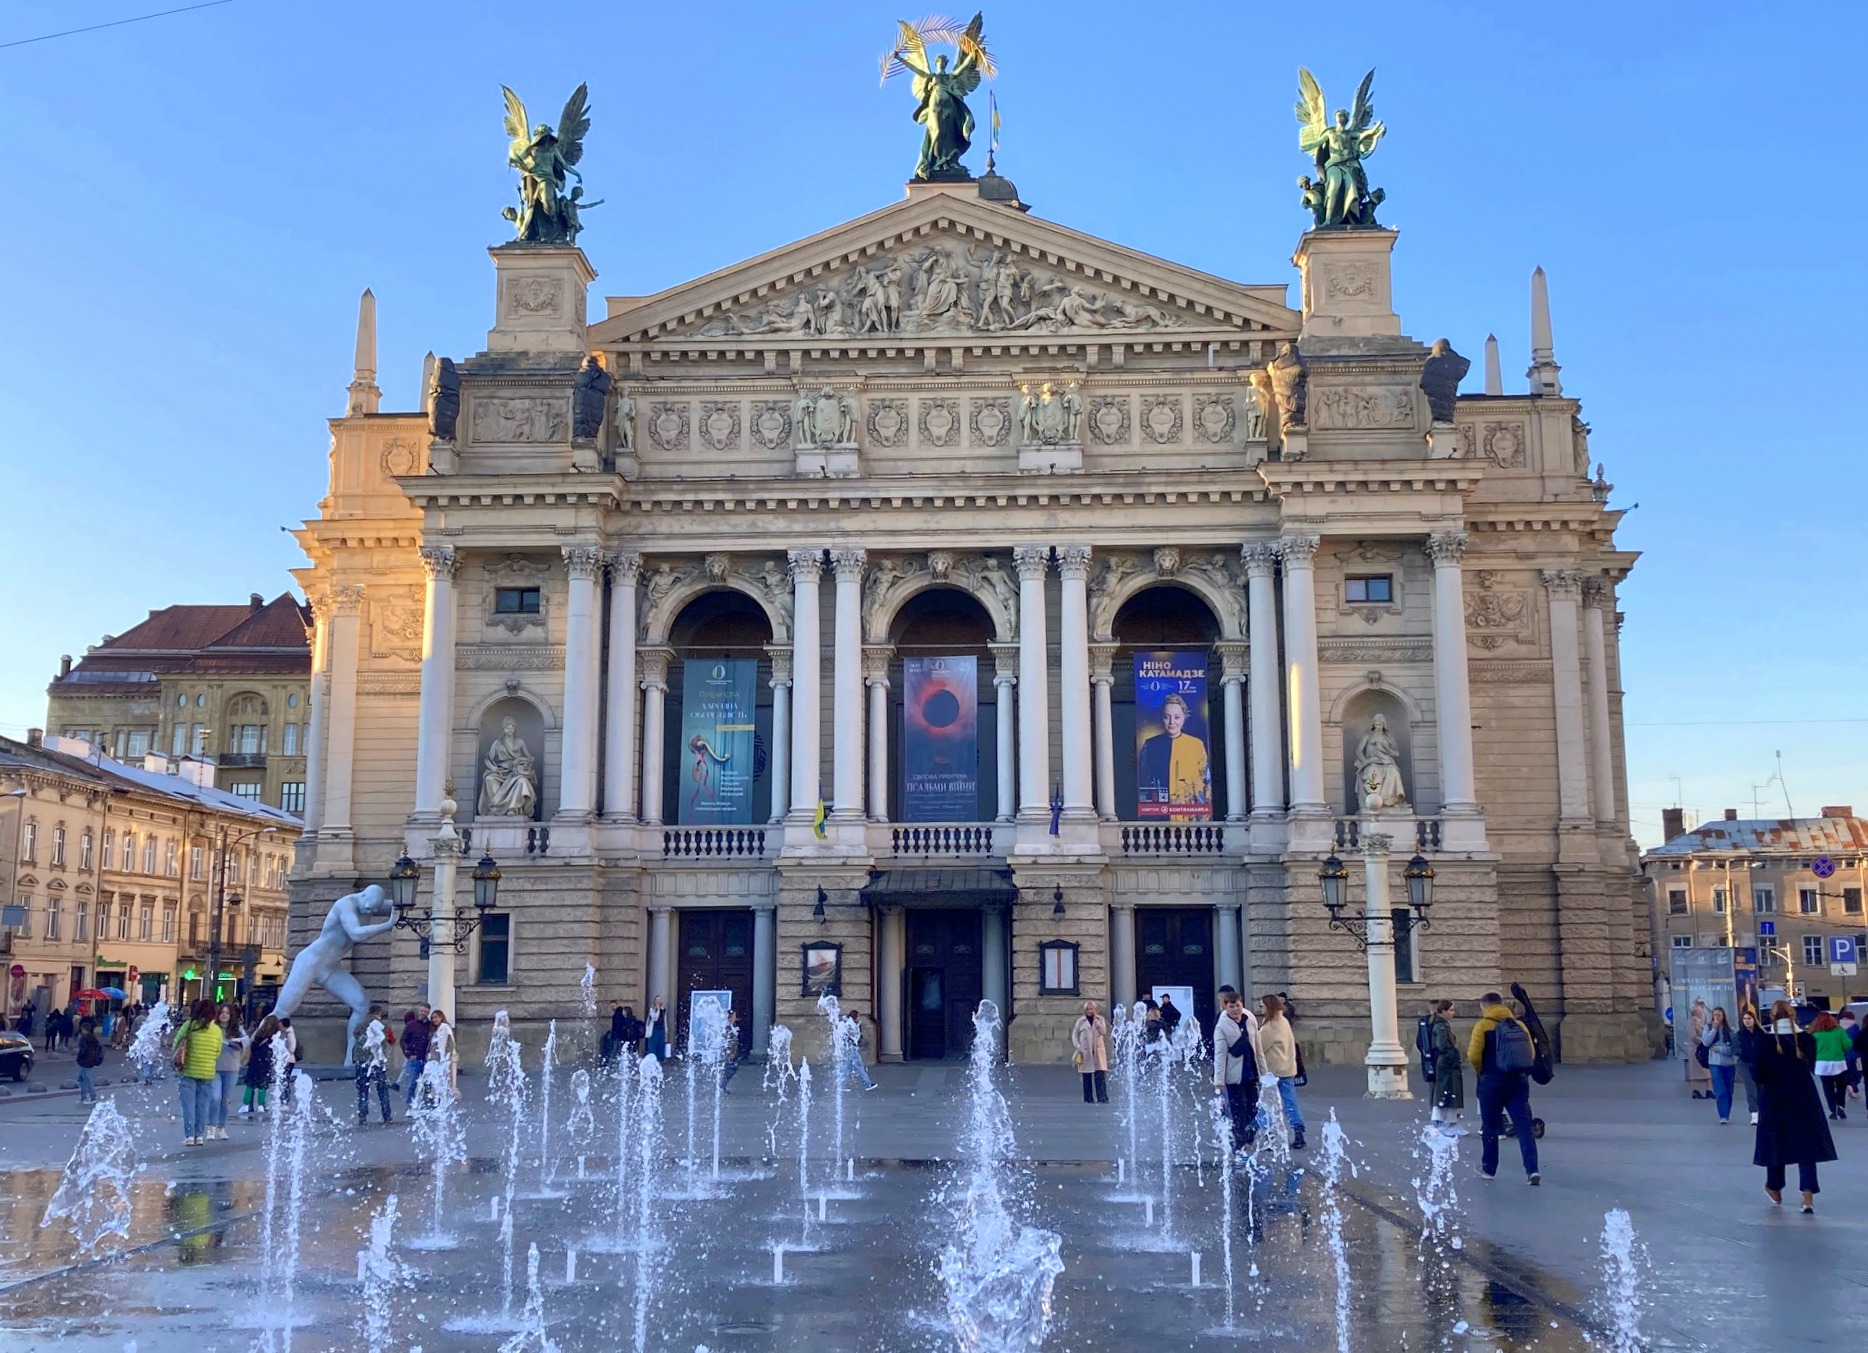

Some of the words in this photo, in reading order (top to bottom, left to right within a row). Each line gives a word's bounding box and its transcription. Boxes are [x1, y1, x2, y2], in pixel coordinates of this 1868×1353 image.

[1143, 662, 1171, 670] НІНО
[1140, 670, 1205, 679] КАТАМАДЗЕ
[1179, 681, 1190, 690] 17
[906, 783, 946, 792] ПСАЛЬМИ
[949, 781, 976, 791] ВІЙНИ
[1836, 940, 1850, 960] P
